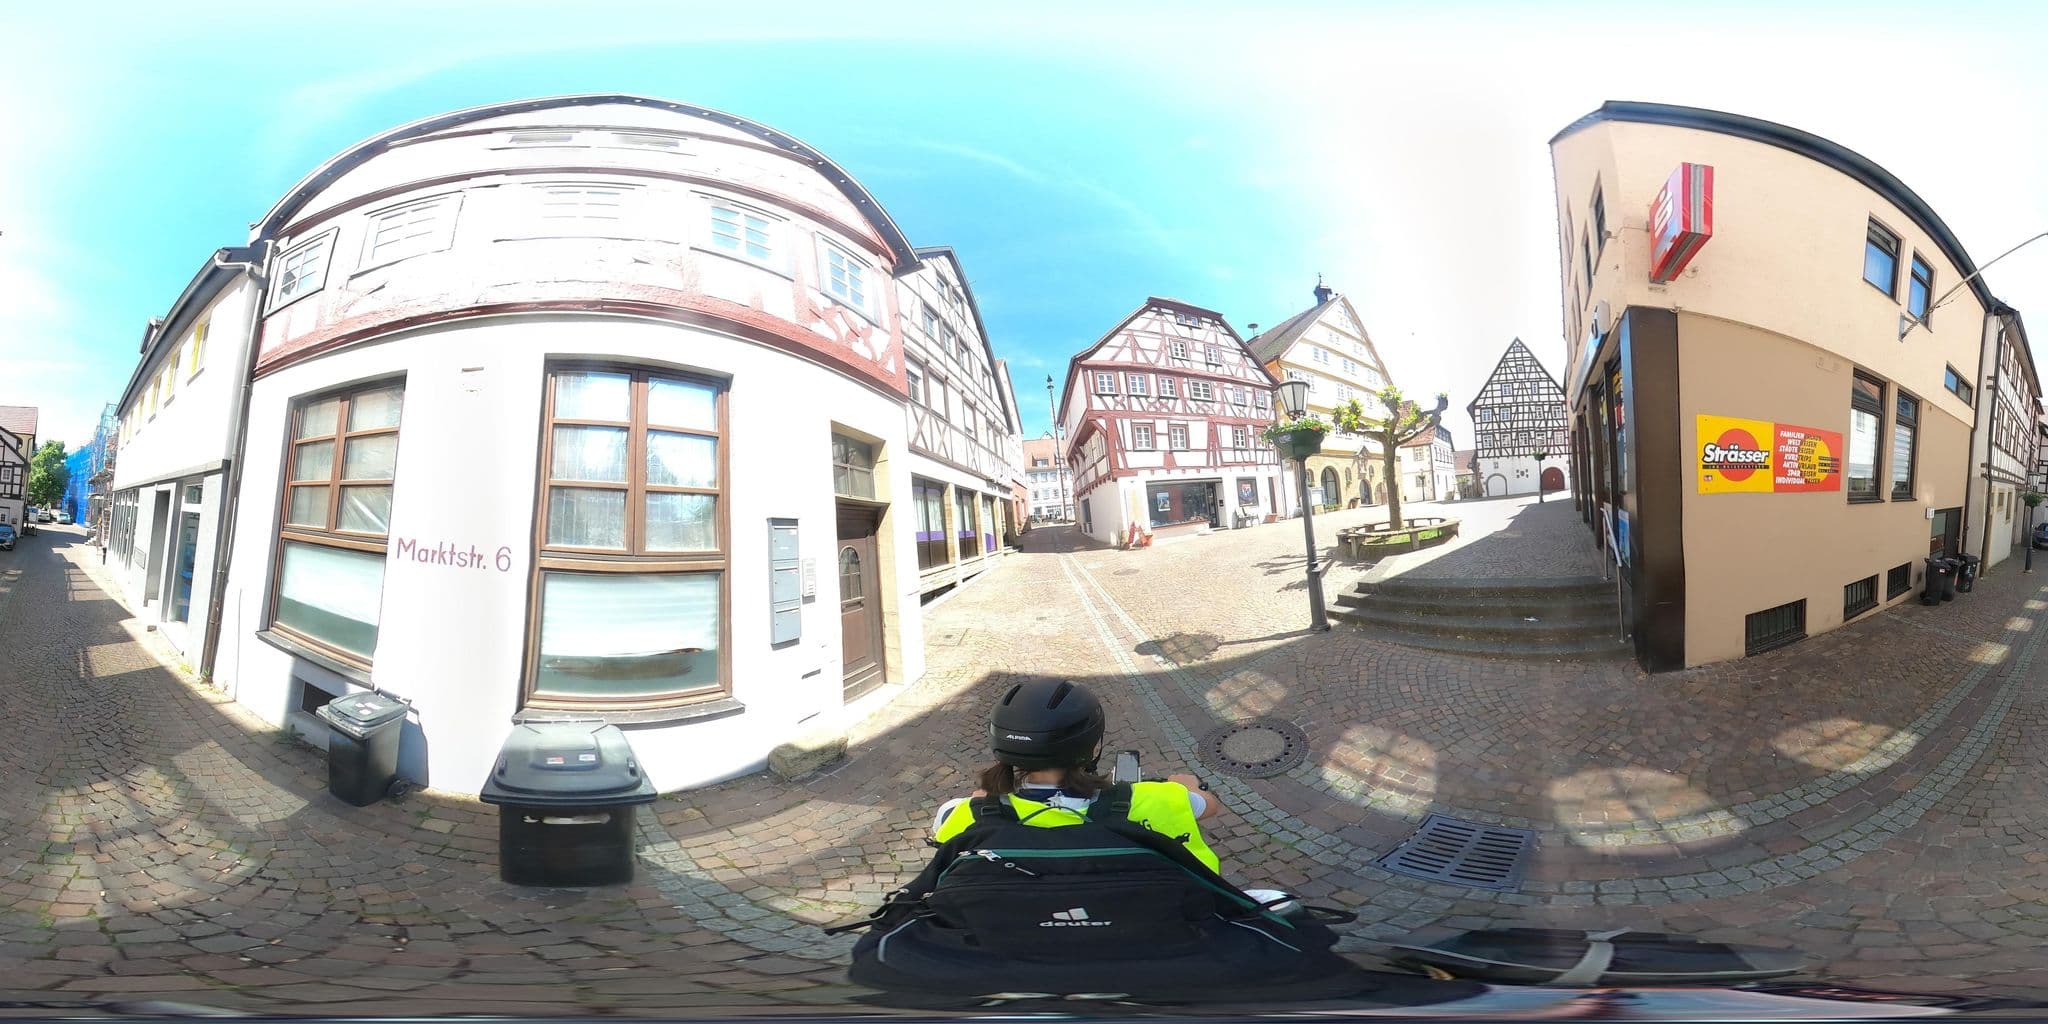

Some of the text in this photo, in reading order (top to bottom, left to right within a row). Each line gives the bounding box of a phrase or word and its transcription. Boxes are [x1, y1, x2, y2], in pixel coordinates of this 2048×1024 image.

[1703, 443, 1769, 463] Strässer
[397, 537, 512, 572] Marktstr. 6
